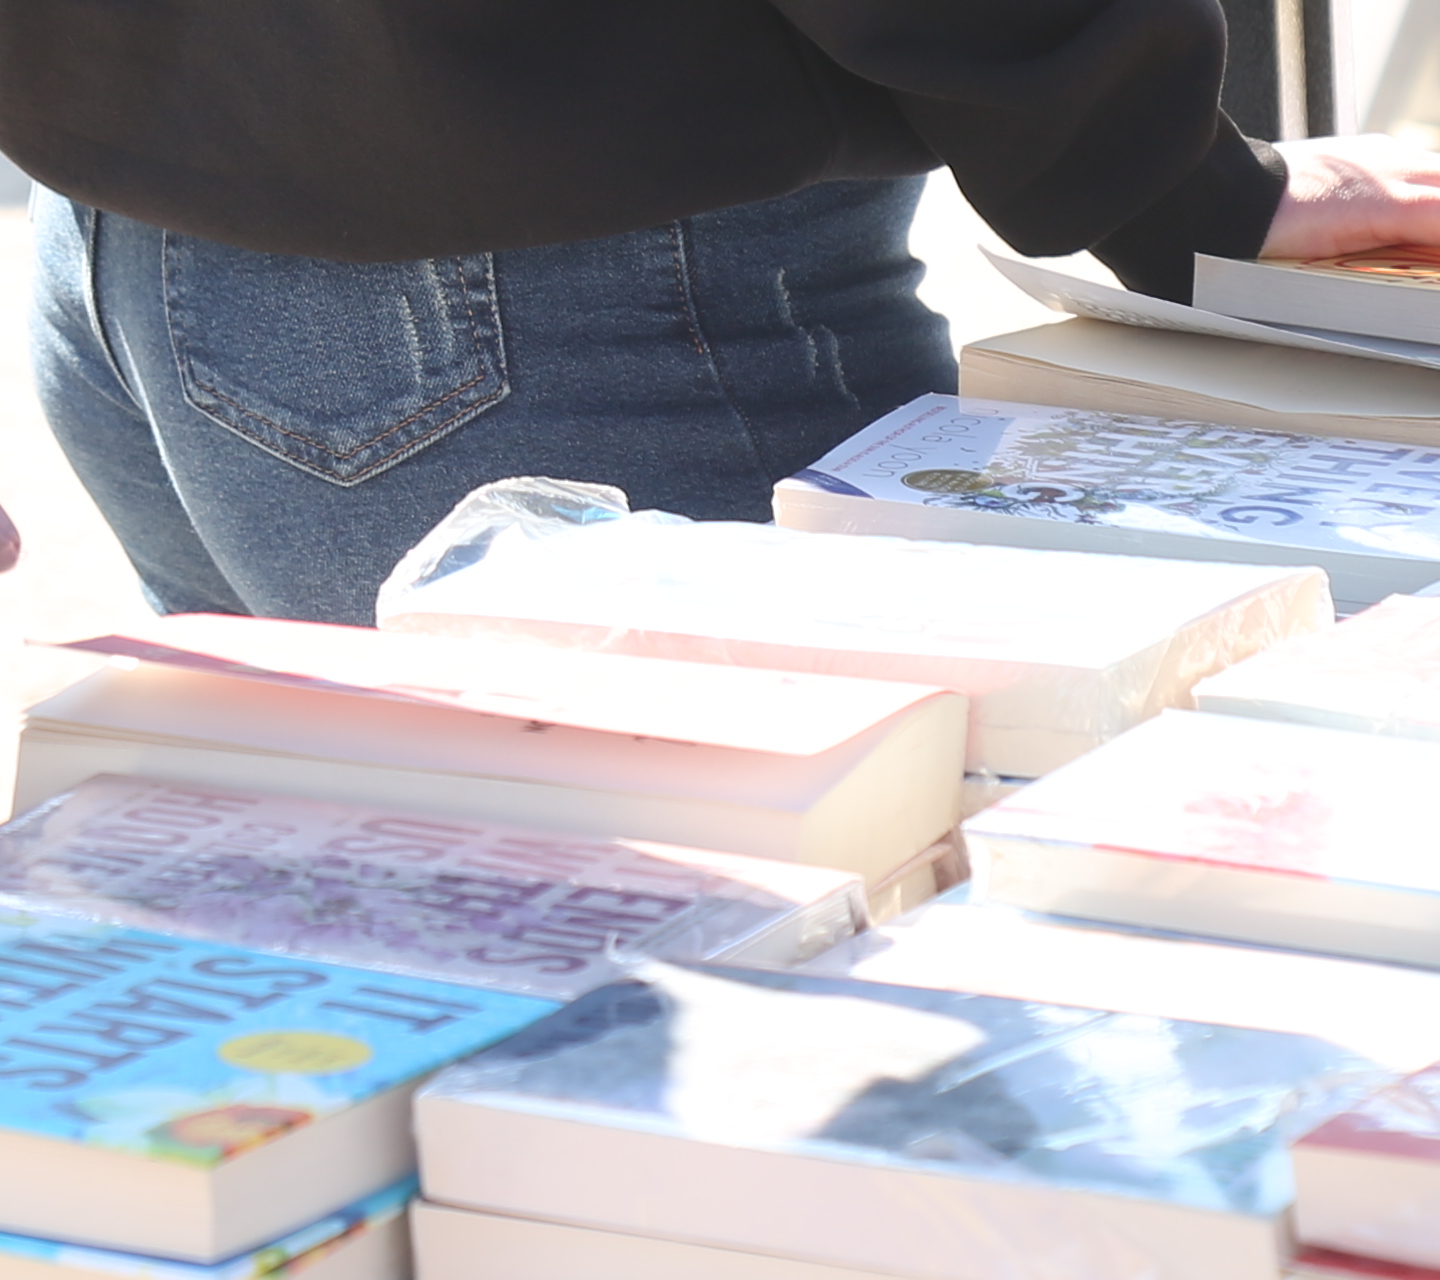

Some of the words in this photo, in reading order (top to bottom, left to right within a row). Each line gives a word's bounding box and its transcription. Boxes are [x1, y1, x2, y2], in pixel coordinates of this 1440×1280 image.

[914, 406, 1007, 443] nicola
[858, 445, 940, 479] yoon
[989, 422, 1196, 505] THING
[314, 815, 489, 865] US
[453, 885, 698, 977] ENDS
[312, 985, 488, 1035] IT
